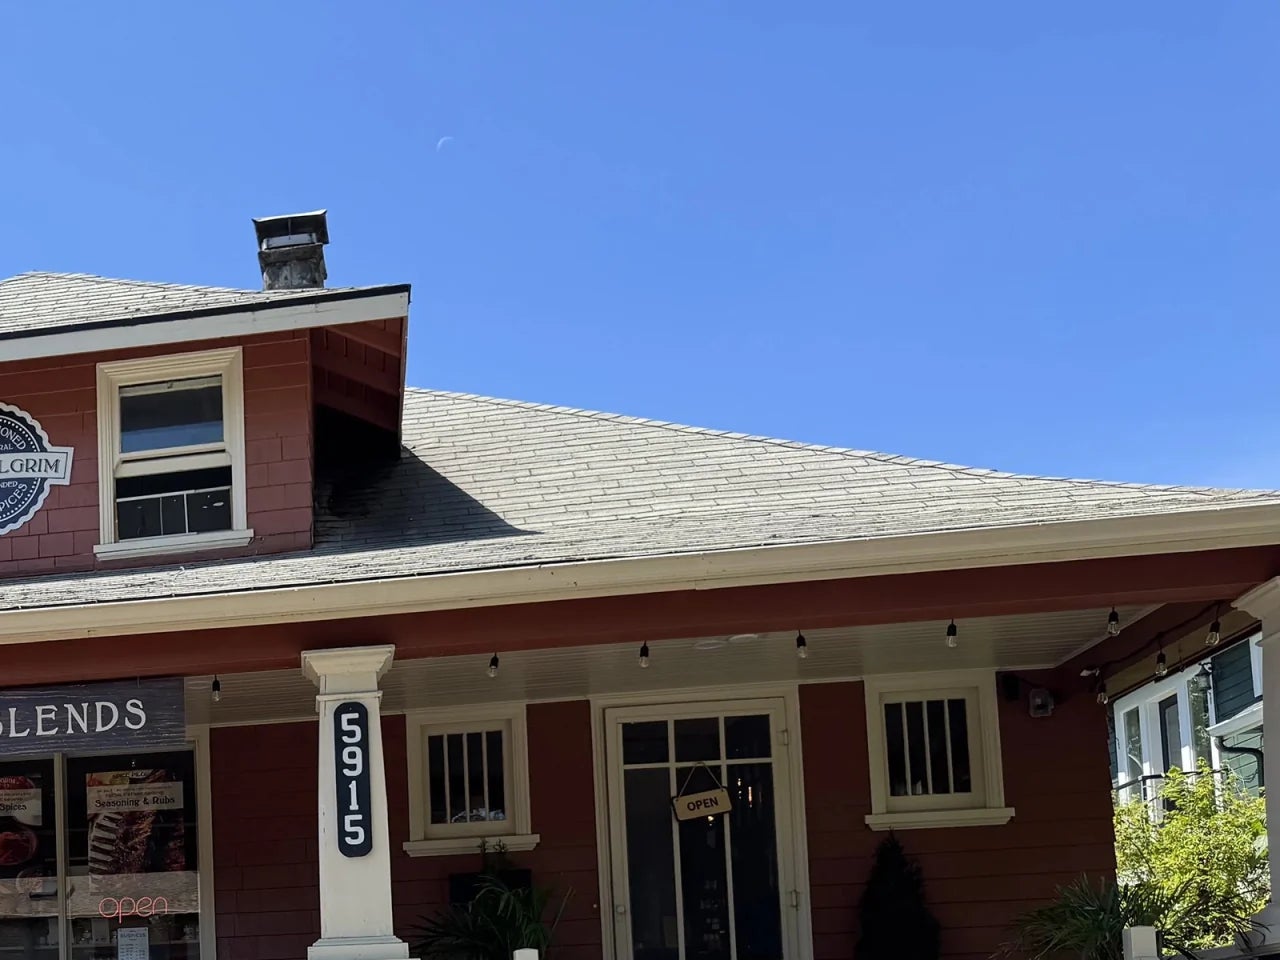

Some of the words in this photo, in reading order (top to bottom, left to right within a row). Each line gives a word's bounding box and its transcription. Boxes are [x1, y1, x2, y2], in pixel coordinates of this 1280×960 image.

[341, 713, 365, 845] 5915
[0, 803, 27, 812] Spices
[95, 798, 140, 808] Seasoning
[687, 797, 719, 811] OPEN
[99, 896, 168, 924] open
